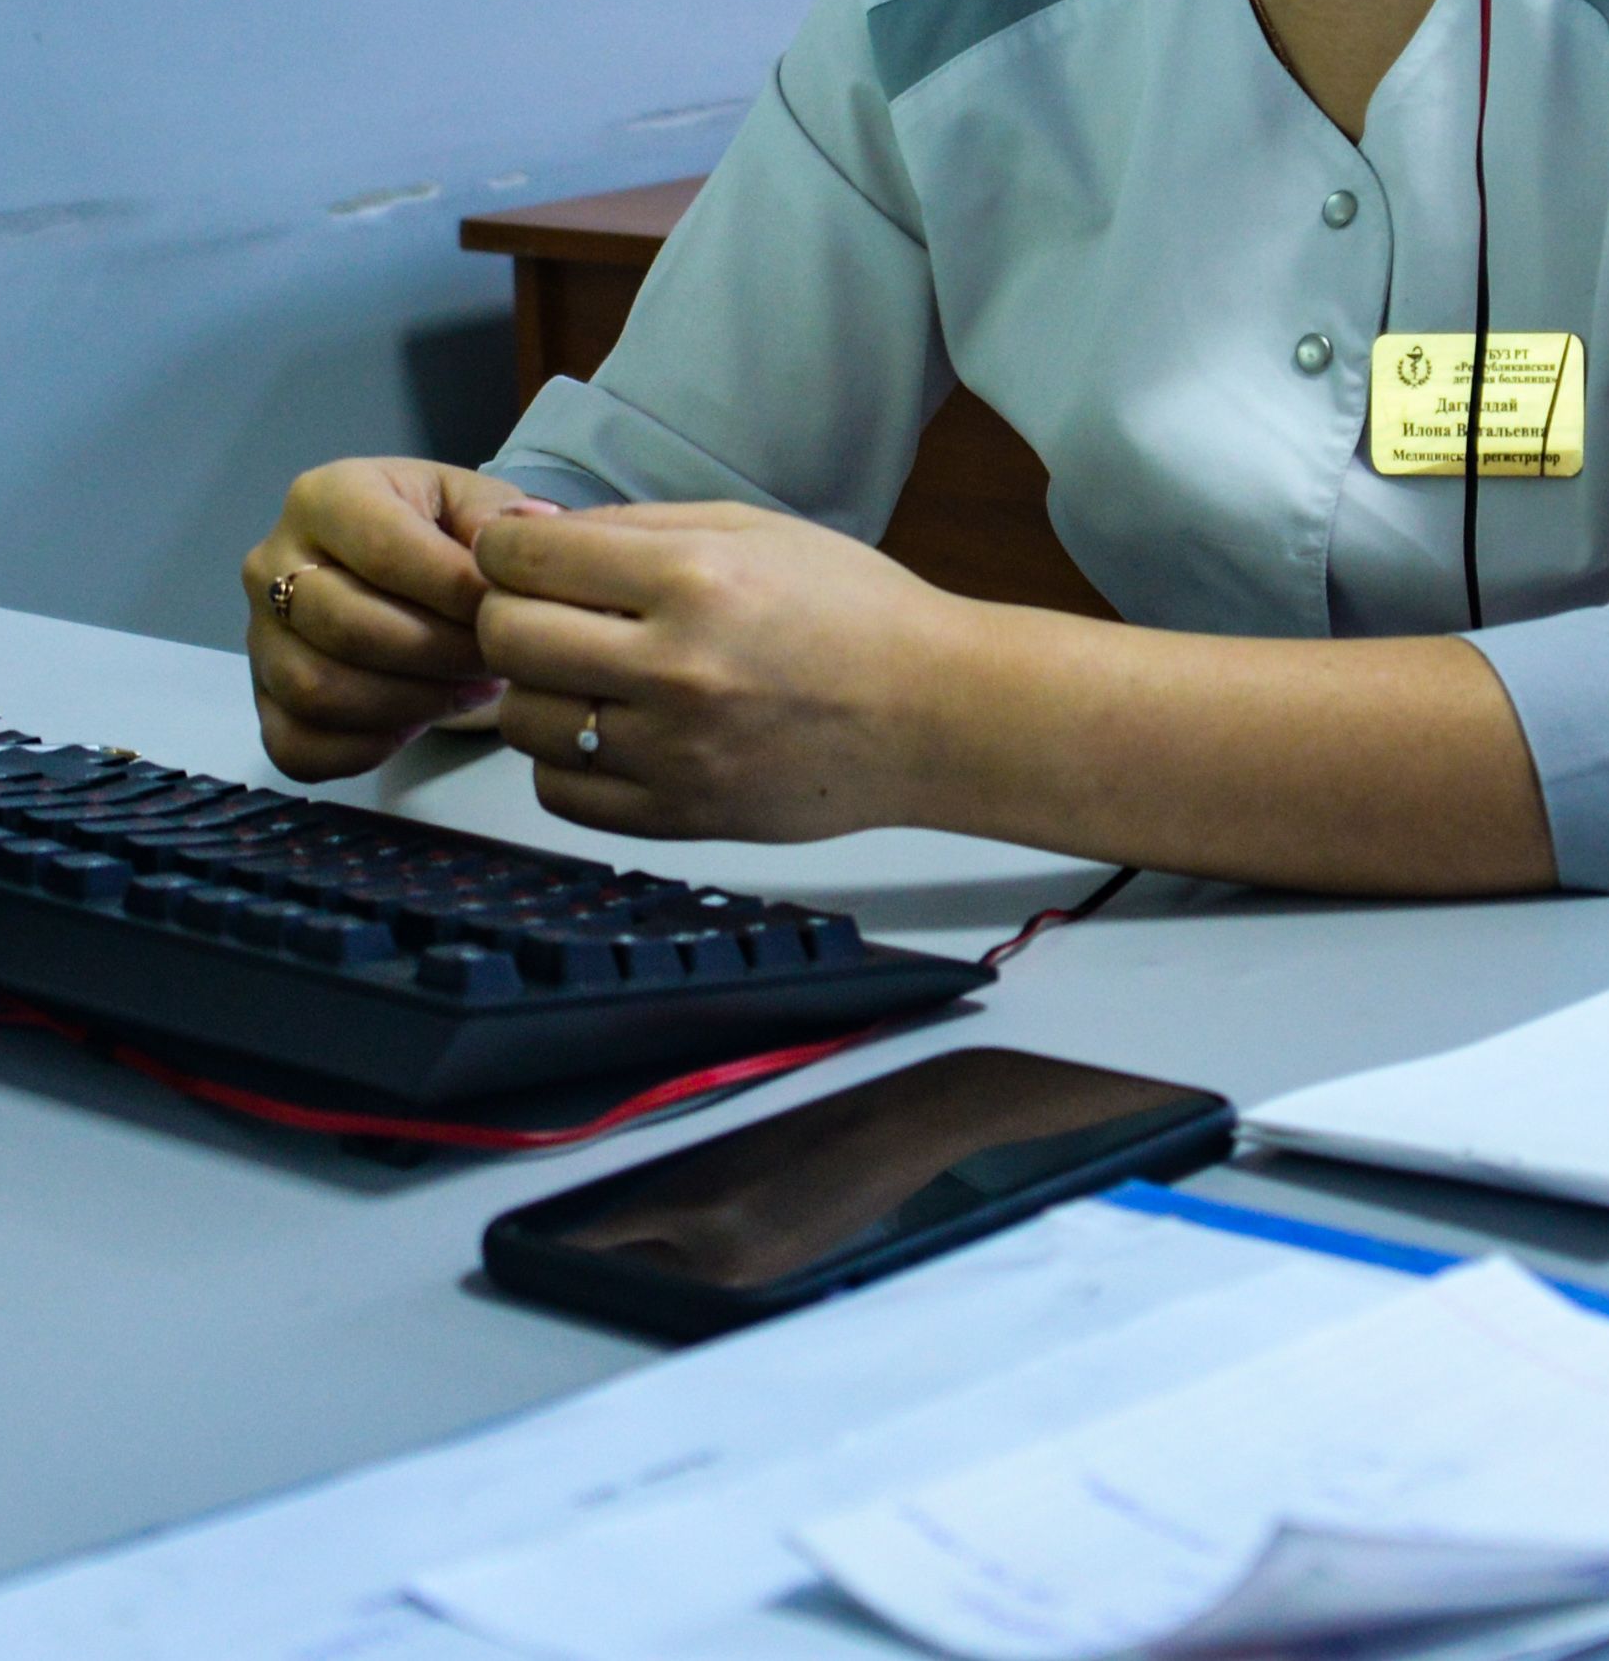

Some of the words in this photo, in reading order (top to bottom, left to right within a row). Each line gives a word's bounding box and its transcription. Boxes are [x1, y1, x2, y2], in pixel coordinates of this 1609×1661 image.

[1485, 349, 1511, 360] БУЗ
[1514, 349, 1529, 360] РТ
[1402, 422, 1452, 438] Илона
[1392, 449, 1478, 462] Медицинск
